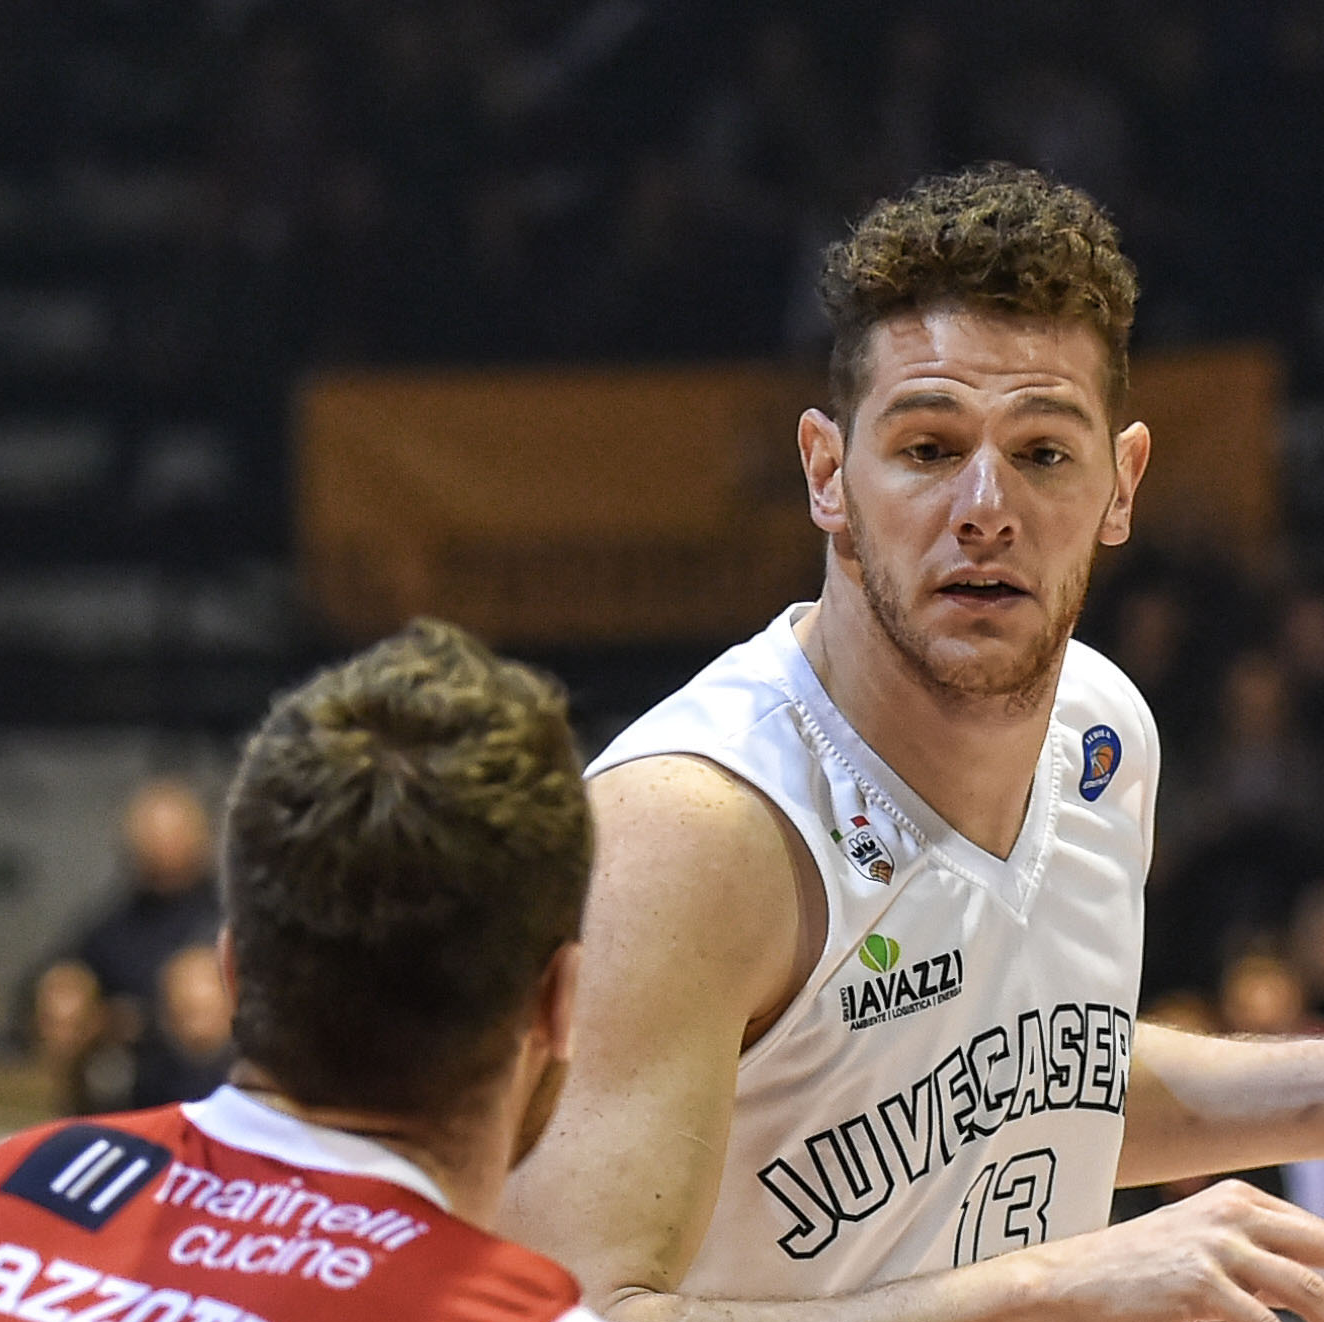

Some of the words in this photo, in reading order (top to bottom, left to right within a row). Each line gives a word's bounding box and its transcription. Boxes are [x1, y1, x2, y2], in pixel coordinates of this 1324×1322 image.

[846, 949, 964, 1021] IAVAZZI
[155, 1161, 430, 1251] marinelli
[952, 1147, 1057, 1269] 13
[169, 1224, 373, 1288] cucine
